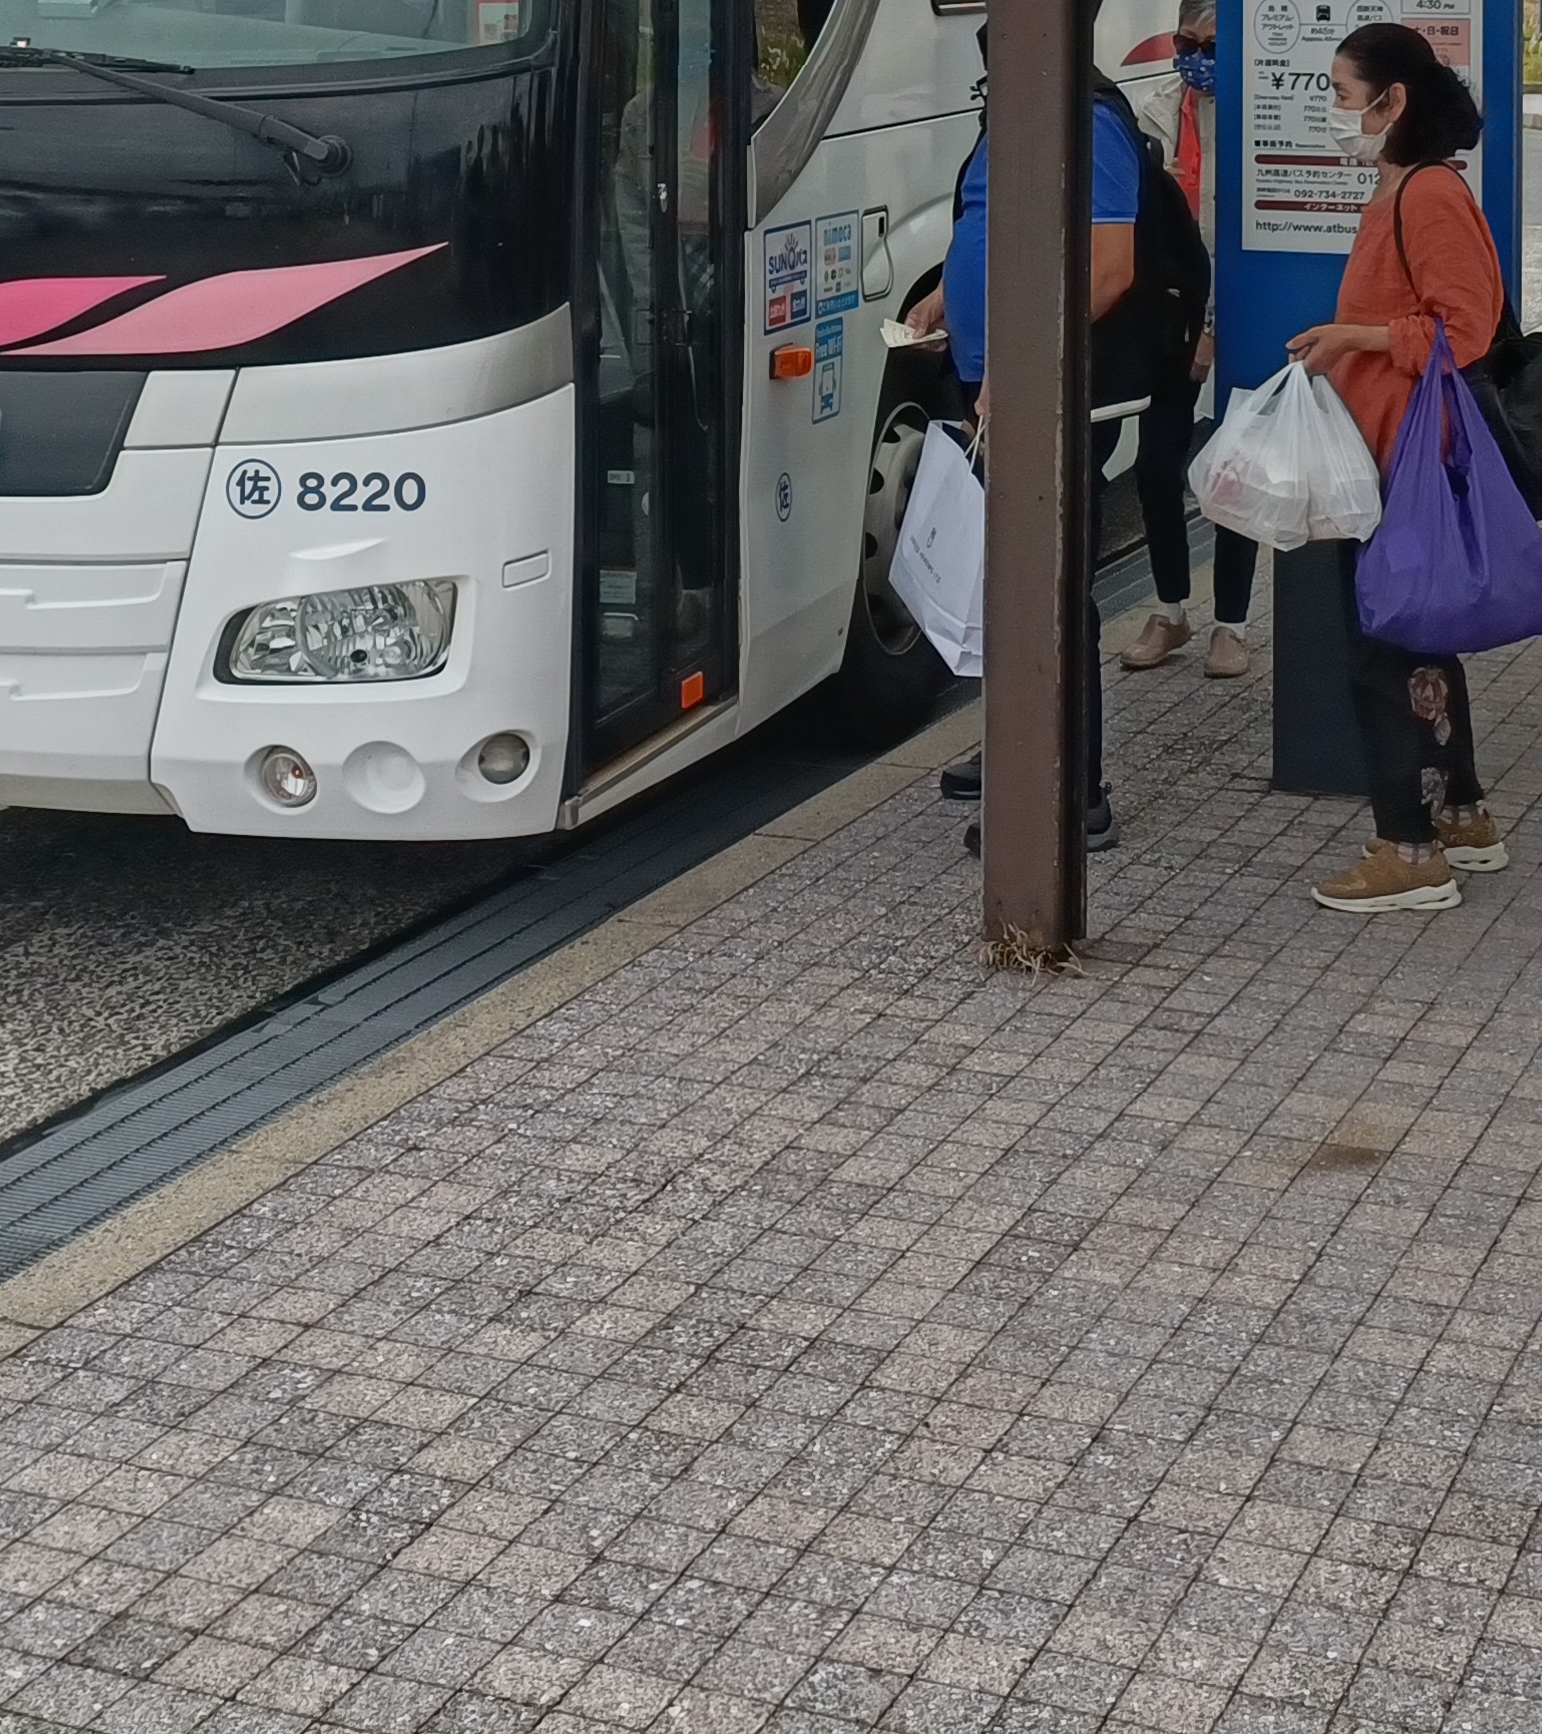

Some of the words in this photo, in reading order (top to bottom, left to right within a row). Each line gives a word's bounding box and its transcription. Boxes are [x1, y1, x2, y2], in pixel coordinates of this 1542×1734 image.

[1270, 71, 1331, 92] ¥770
[1293, 189, 1366, 200] 092-734-2727
[236, 469, 273, 508] 佐
[296, 471, 427, 513] 8220
